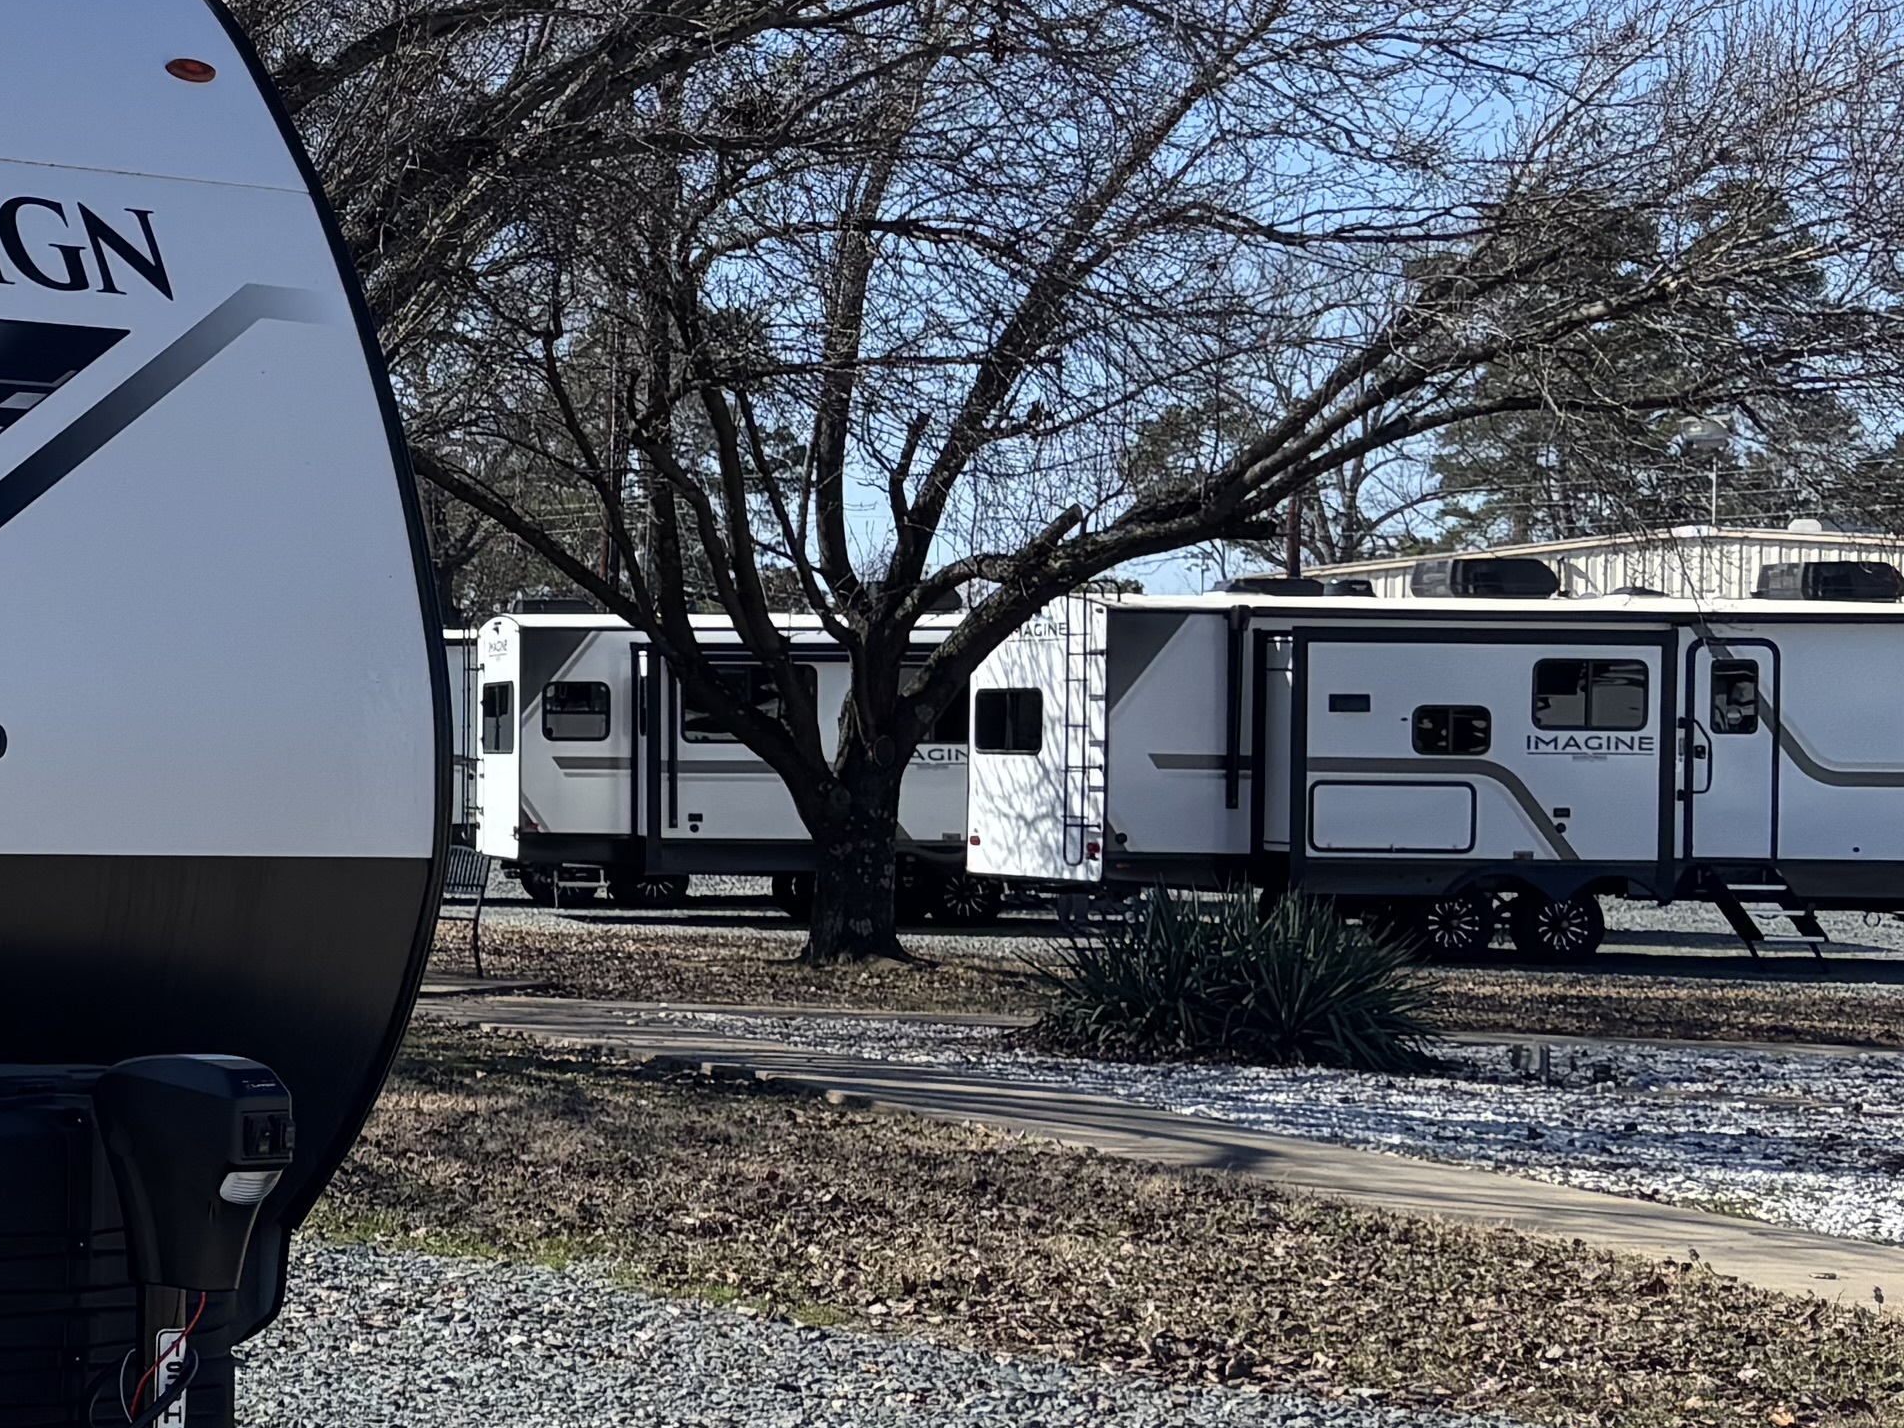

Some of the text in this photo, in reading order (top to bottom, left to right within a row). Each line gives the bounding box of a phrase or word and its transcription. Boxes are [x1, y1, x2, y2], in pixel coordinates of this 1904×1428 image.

[1013, 621, 1069, 638] AGINE
[1526, 734, 1655, 752] IMAGINE
[911, 747, 970, 762] AGIN
